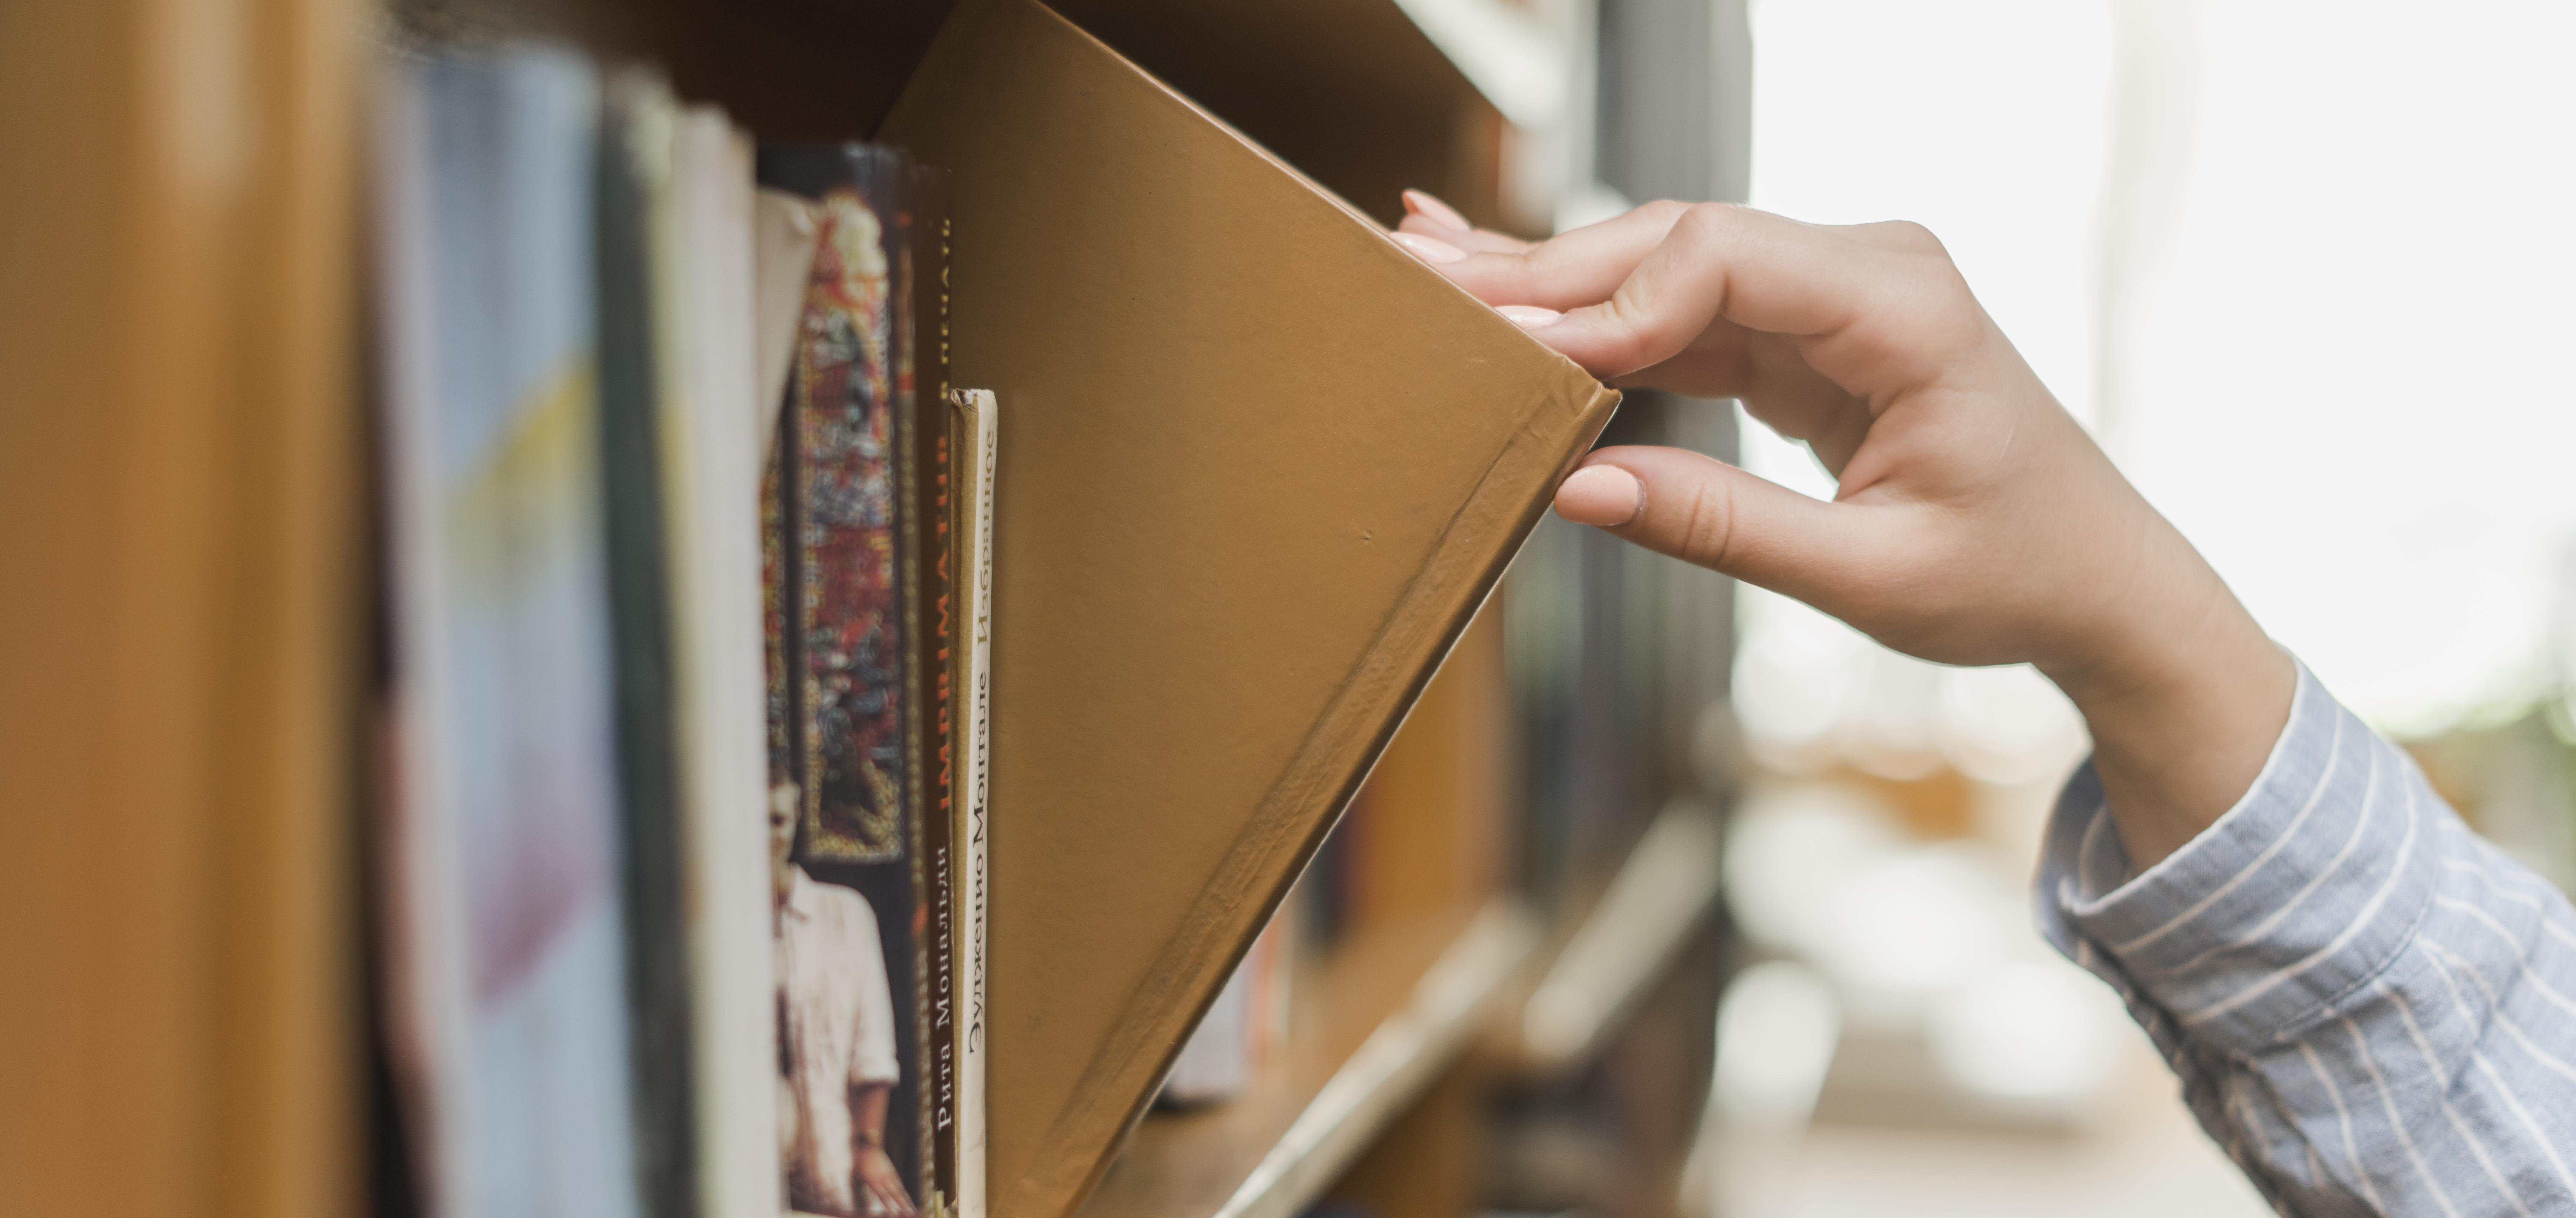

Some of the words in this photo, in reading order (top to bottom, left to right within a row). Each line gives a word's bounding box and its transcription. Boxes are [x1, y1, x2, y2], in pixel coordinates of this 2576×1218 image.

[937, 435, 951, 811] IMPRIMATUR
[978, 429, 994, 647] Избранное
[973, 670, 987, 847] Монтале
[936, 846, 949, 1029] Мональди
[969, 853, 983, 1053] Эудженио
[936, 1040, 952, 1131] Рита
